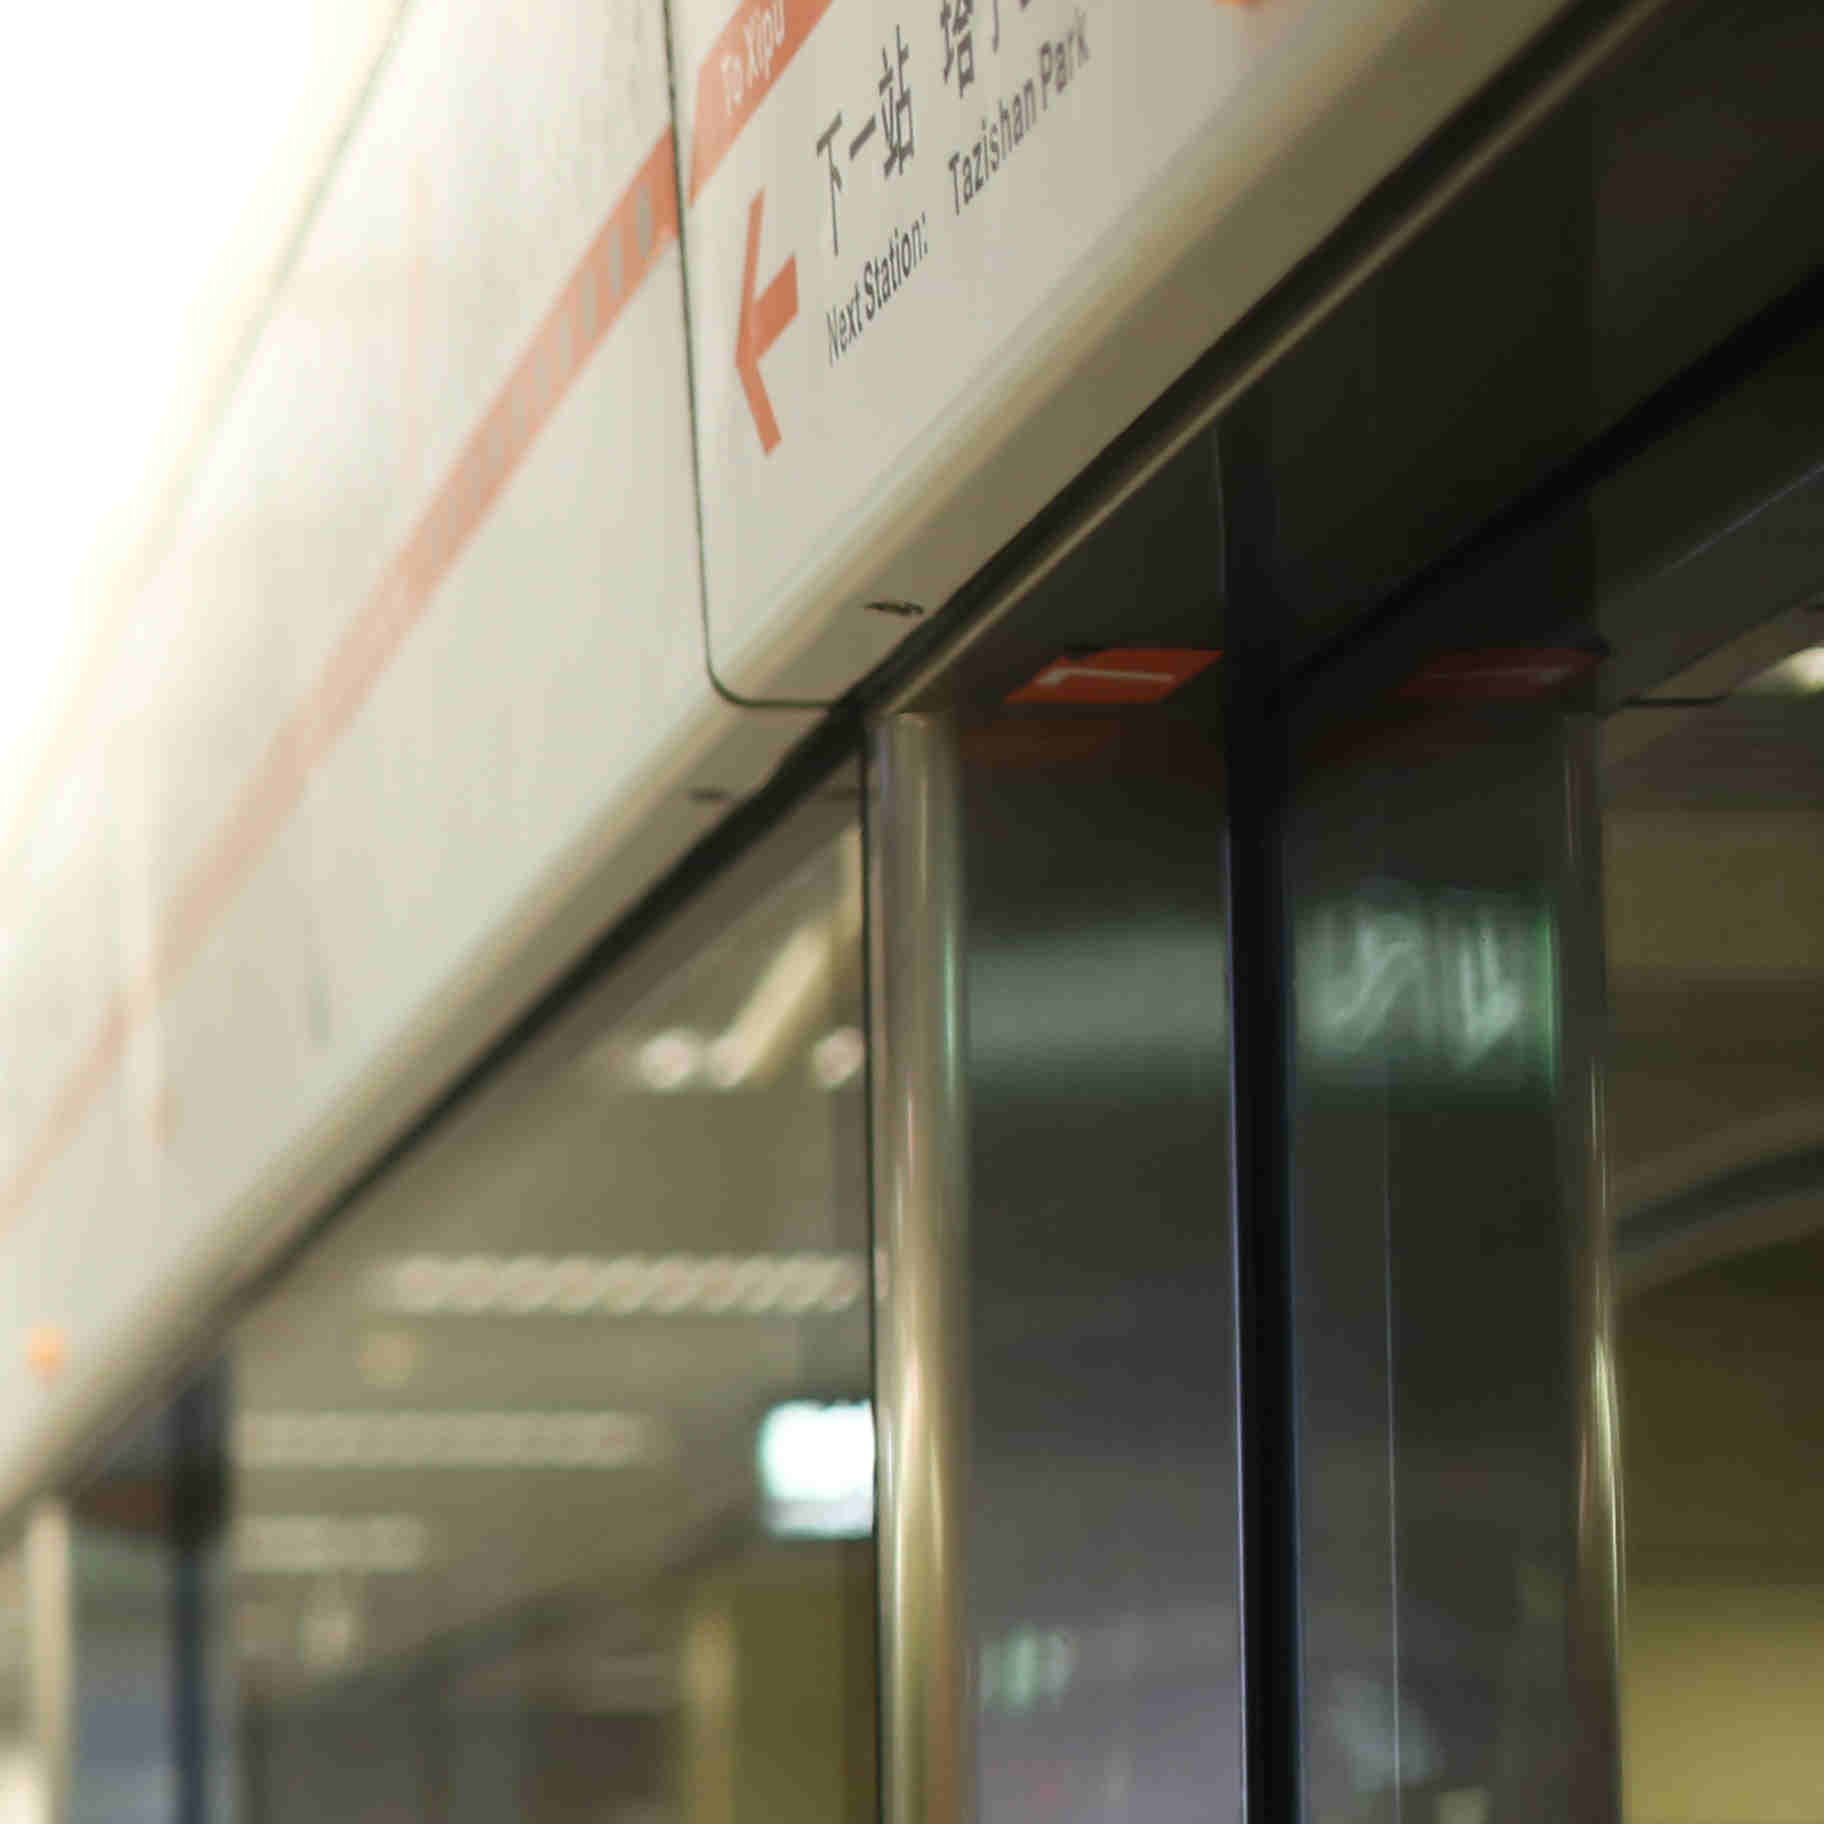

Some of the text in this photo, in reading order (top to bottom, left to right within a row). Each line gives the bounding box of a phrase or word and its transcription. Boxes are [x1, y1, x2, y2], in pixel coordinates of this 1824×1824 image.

[817, 24, 915, 256] 下一站
[826, 6, 1088, 368] Next Station: Tazishan Park
